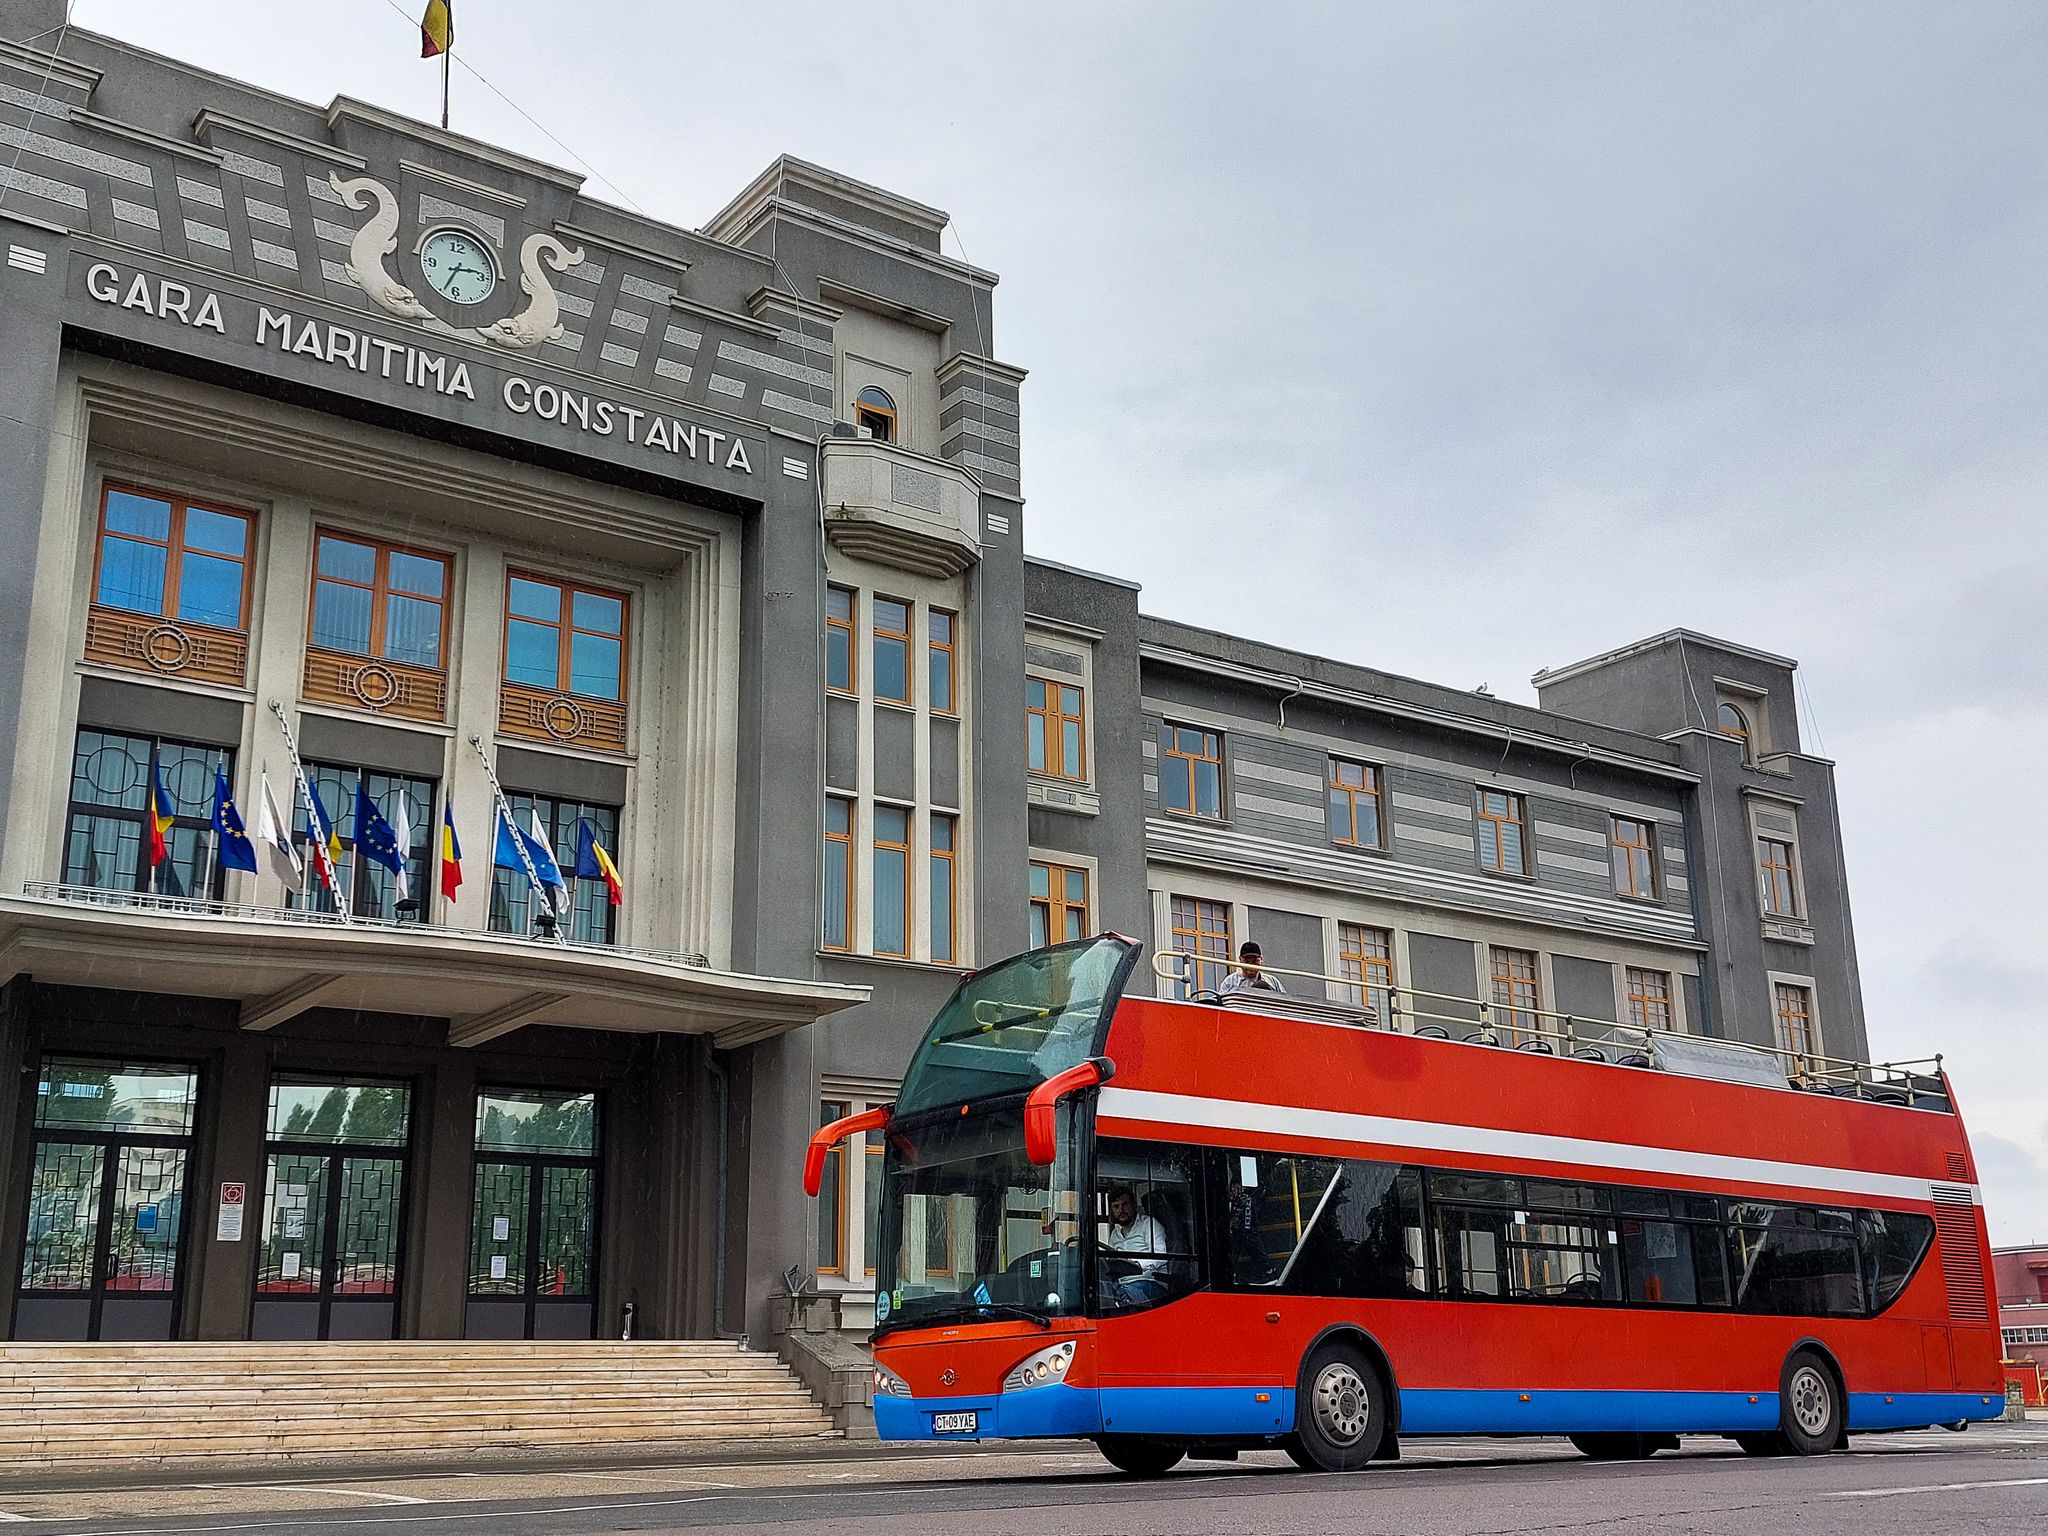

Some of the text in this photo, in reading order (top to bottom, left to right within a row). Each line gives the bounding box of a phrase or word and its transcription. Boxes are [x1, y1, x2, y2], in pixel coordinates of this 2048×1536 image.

[449, 242, 466, 254] 12
[428, 258, 437, 267] 9
[476, 272, 485, 281] 3
[451, 287, 460, 296] 6
[86, 263, 752, 473] GARA MARITIMA CONSTANTA
